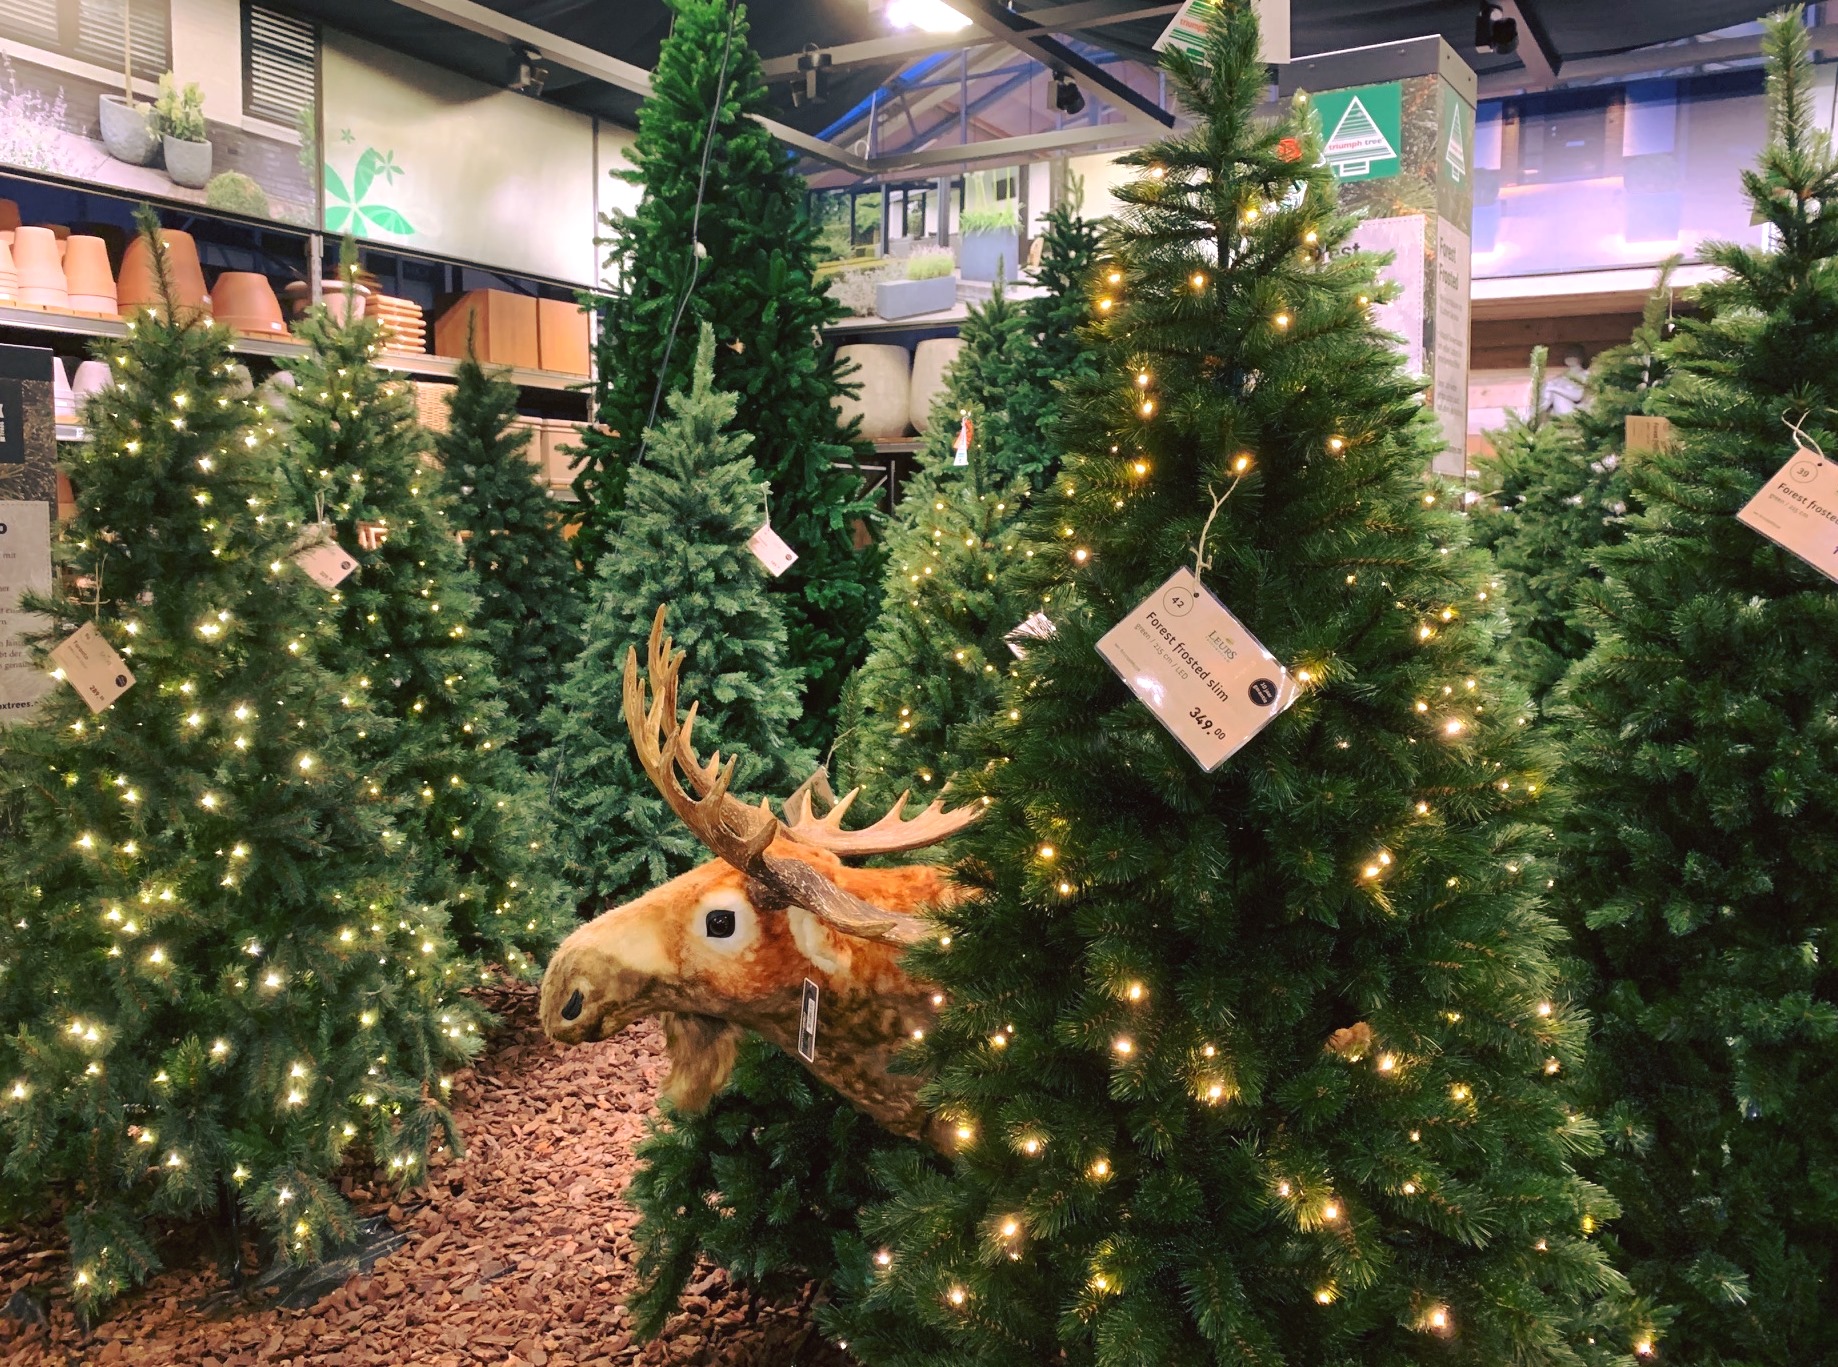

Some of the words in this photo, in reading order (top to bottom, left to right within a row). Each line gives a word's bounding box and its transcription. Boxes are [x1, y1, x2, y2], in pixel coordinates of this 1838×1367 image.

[1328, 139, 1362, 151] triumph
[1364, 138, 1382, 146] tree
[1796, 467, 1810, 478] 39
[1777, 483, 1807, 505] Forest
[1172, 597, 1185, 608] 42
[1134, 623, 1151, 640] green
[1153, 643, 1164, 655] 215
[1163, 653, 1173, 665] cm
[1175, 666, 1189, 680] LED
[1146, 611, 1176, 645] Forest
[1172, 642, 1211, 681] frosted
[1206, 679, 1229, 702] slim
